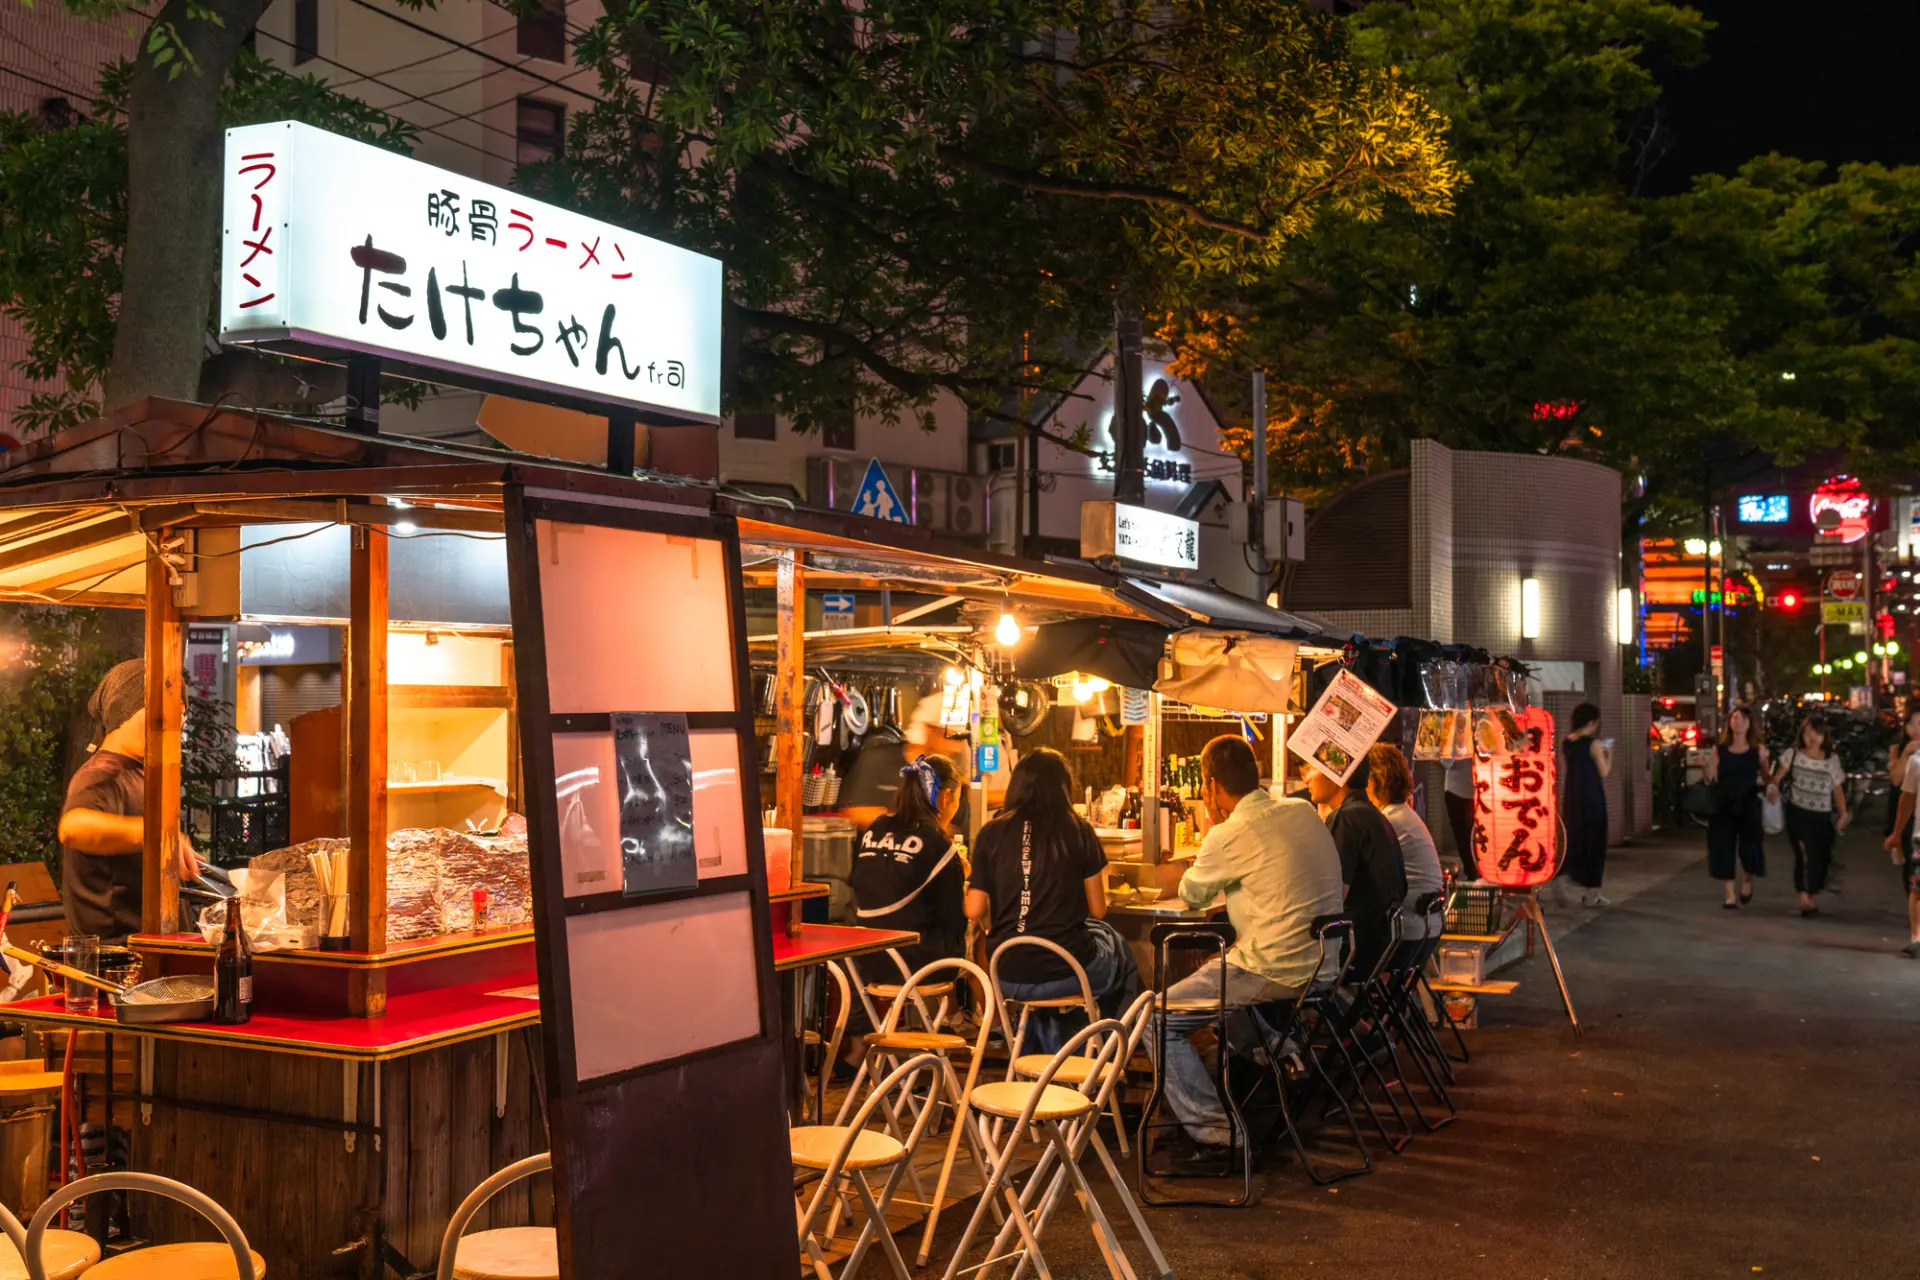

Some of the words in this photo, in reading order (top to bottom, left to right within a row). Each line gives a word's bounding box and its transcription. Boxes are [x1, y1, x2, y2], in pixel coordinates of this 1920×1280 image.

[238, 152, 276, 309] ラーメン
[427, 189, 634, 280] 豚骨ラーメン
[350, 233, 641, 381] たけちゃん
[1118, 533, 1134, 546] YATA
